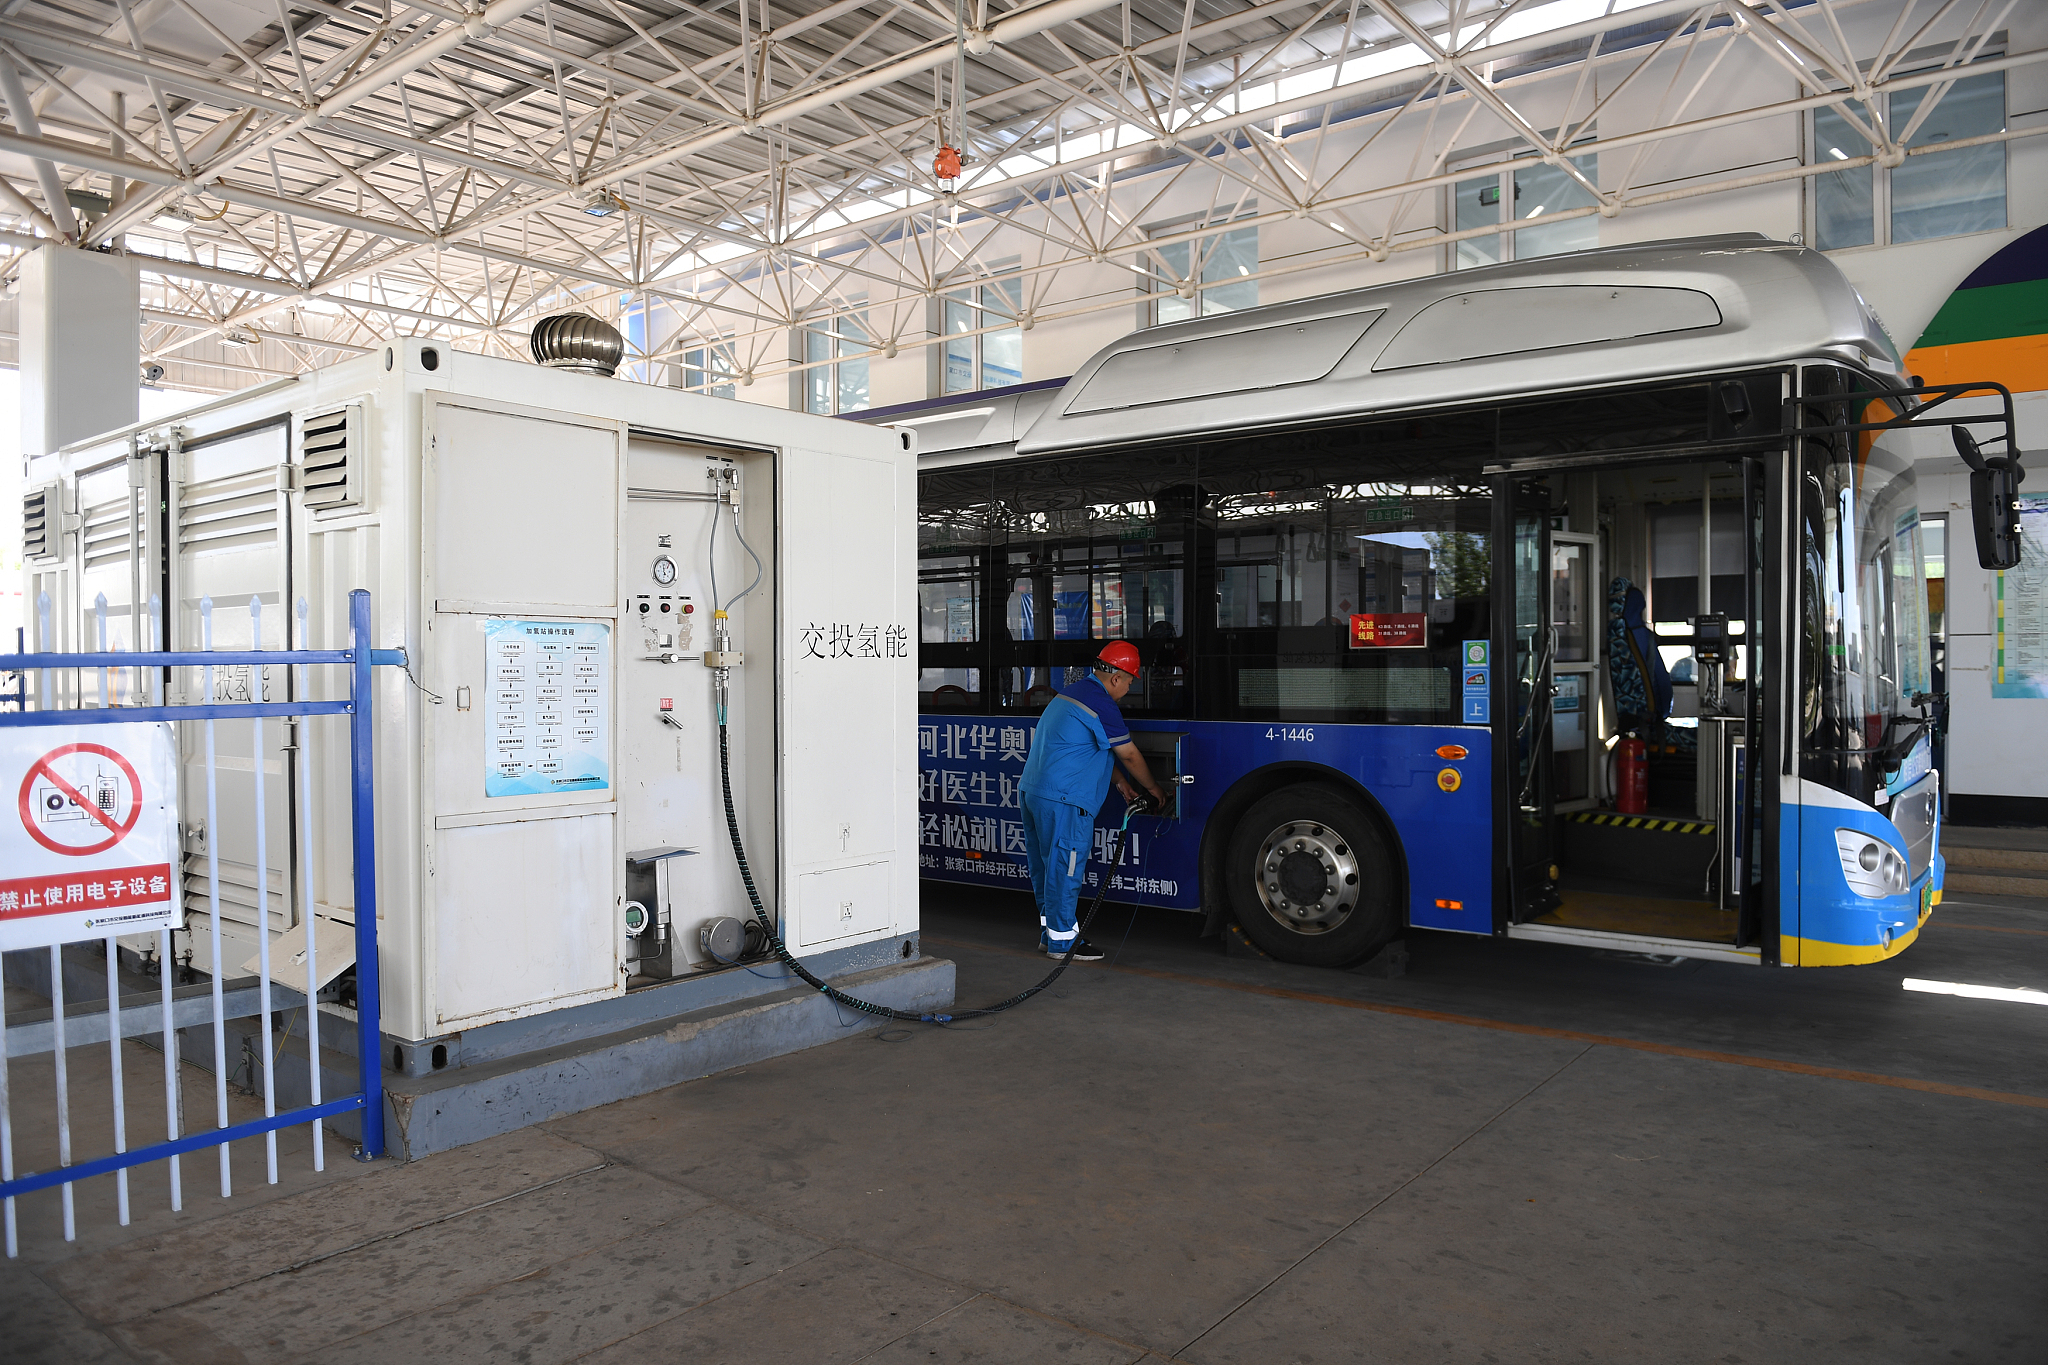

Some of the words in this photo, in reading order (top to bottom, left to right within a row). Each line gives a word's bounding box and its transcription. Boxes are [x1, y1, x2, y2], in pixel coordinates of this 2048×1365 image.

[525, 627, 575, 636] 加氢站操作流程
[1358, 621, 1374, 629] 先进
[1358, 631, 1374, 640] 线路
[799, 622, 908, 660] 交投氢能
[1469, 702, 1484, 716] 上
[918, 724, 1036, 762] 河北华奥
[1265, 728, 1315, 742] 4-1446
[919, 812, 1028, 856] 轻松就医
[1088, 827, 1140, 866] 验!
[919, 853, 1032, 879] 地址:张家口市经开区长
[1081, 871, 1178, 897] 1号纬二桥东侧)
[0, 875, 168, 911] 禁止使用电子设备
